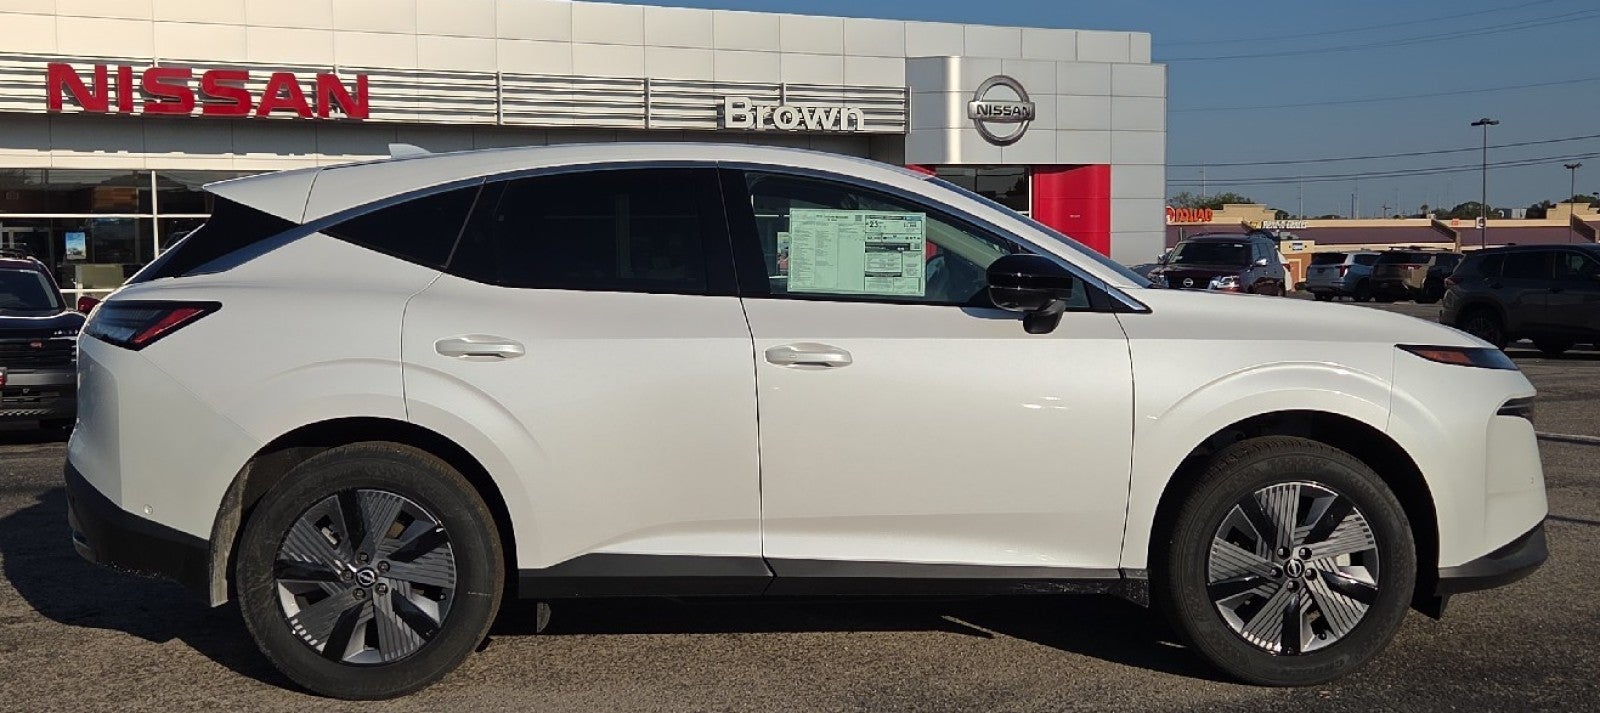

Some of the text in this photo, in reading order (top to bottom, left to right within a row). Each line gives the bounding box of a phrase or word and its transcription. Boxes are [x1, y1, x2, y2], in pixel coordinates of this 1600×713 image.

[47, 62, 369, 119] NISSAN
[724, 97, 865, 131] Brown
[976, 104, 1031, 117] NISSAN
